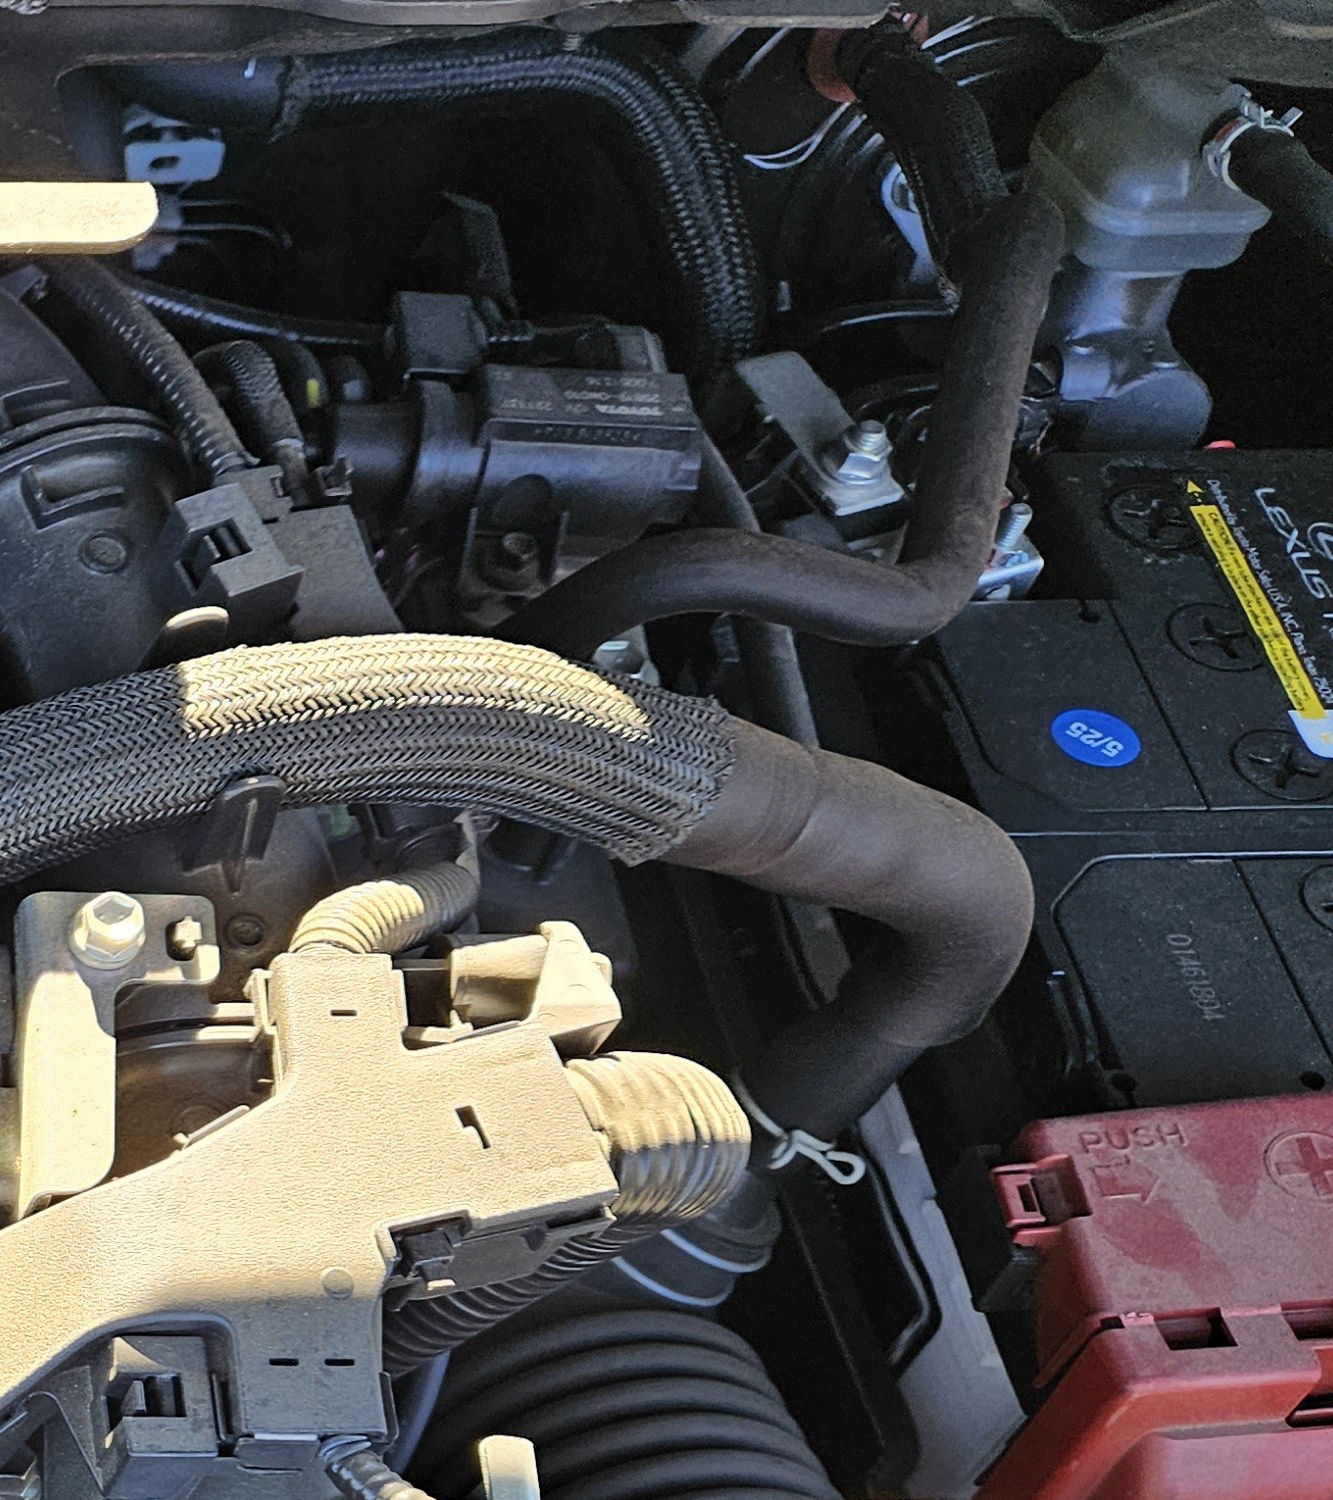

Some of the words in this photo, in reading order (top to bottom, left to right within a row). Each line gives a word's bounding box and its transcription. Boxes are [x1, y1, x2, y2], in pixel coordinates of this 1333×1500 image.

[1254, 488, 1333, 599] LEXUS
[1065, 722, 1124, 758] 5/25
[1079, 1122, 1187, 1153] PUSH
